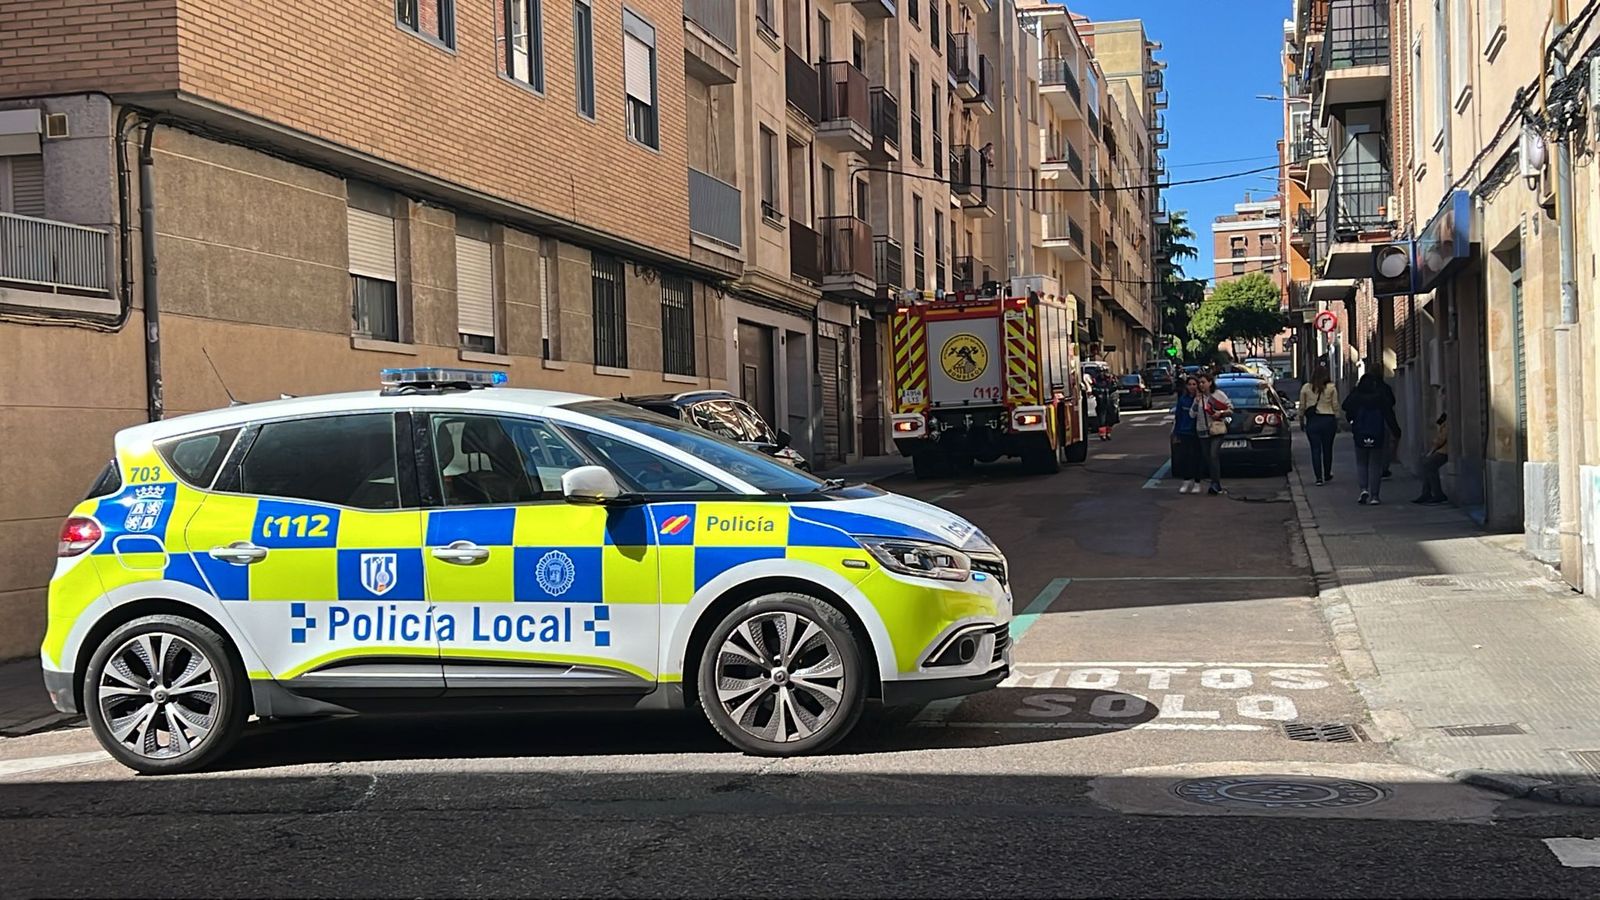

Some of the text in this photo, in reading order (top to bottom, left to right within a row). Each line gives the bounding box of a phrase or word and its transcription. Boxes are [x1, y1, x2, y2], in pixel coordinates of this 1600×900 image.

[980, 386, 1000, 399] 112
[130, 467, 161, 482] 703
[273, 514, 331, 538] 112
[707, 516, 775, 532] Policía
[364, 556, 394, 592] 175
[329, 605, 570, 642] Policía Local
[998, 666, 1330, 690] MOTOS
[1017, 693, 1298, 720] SOLO
